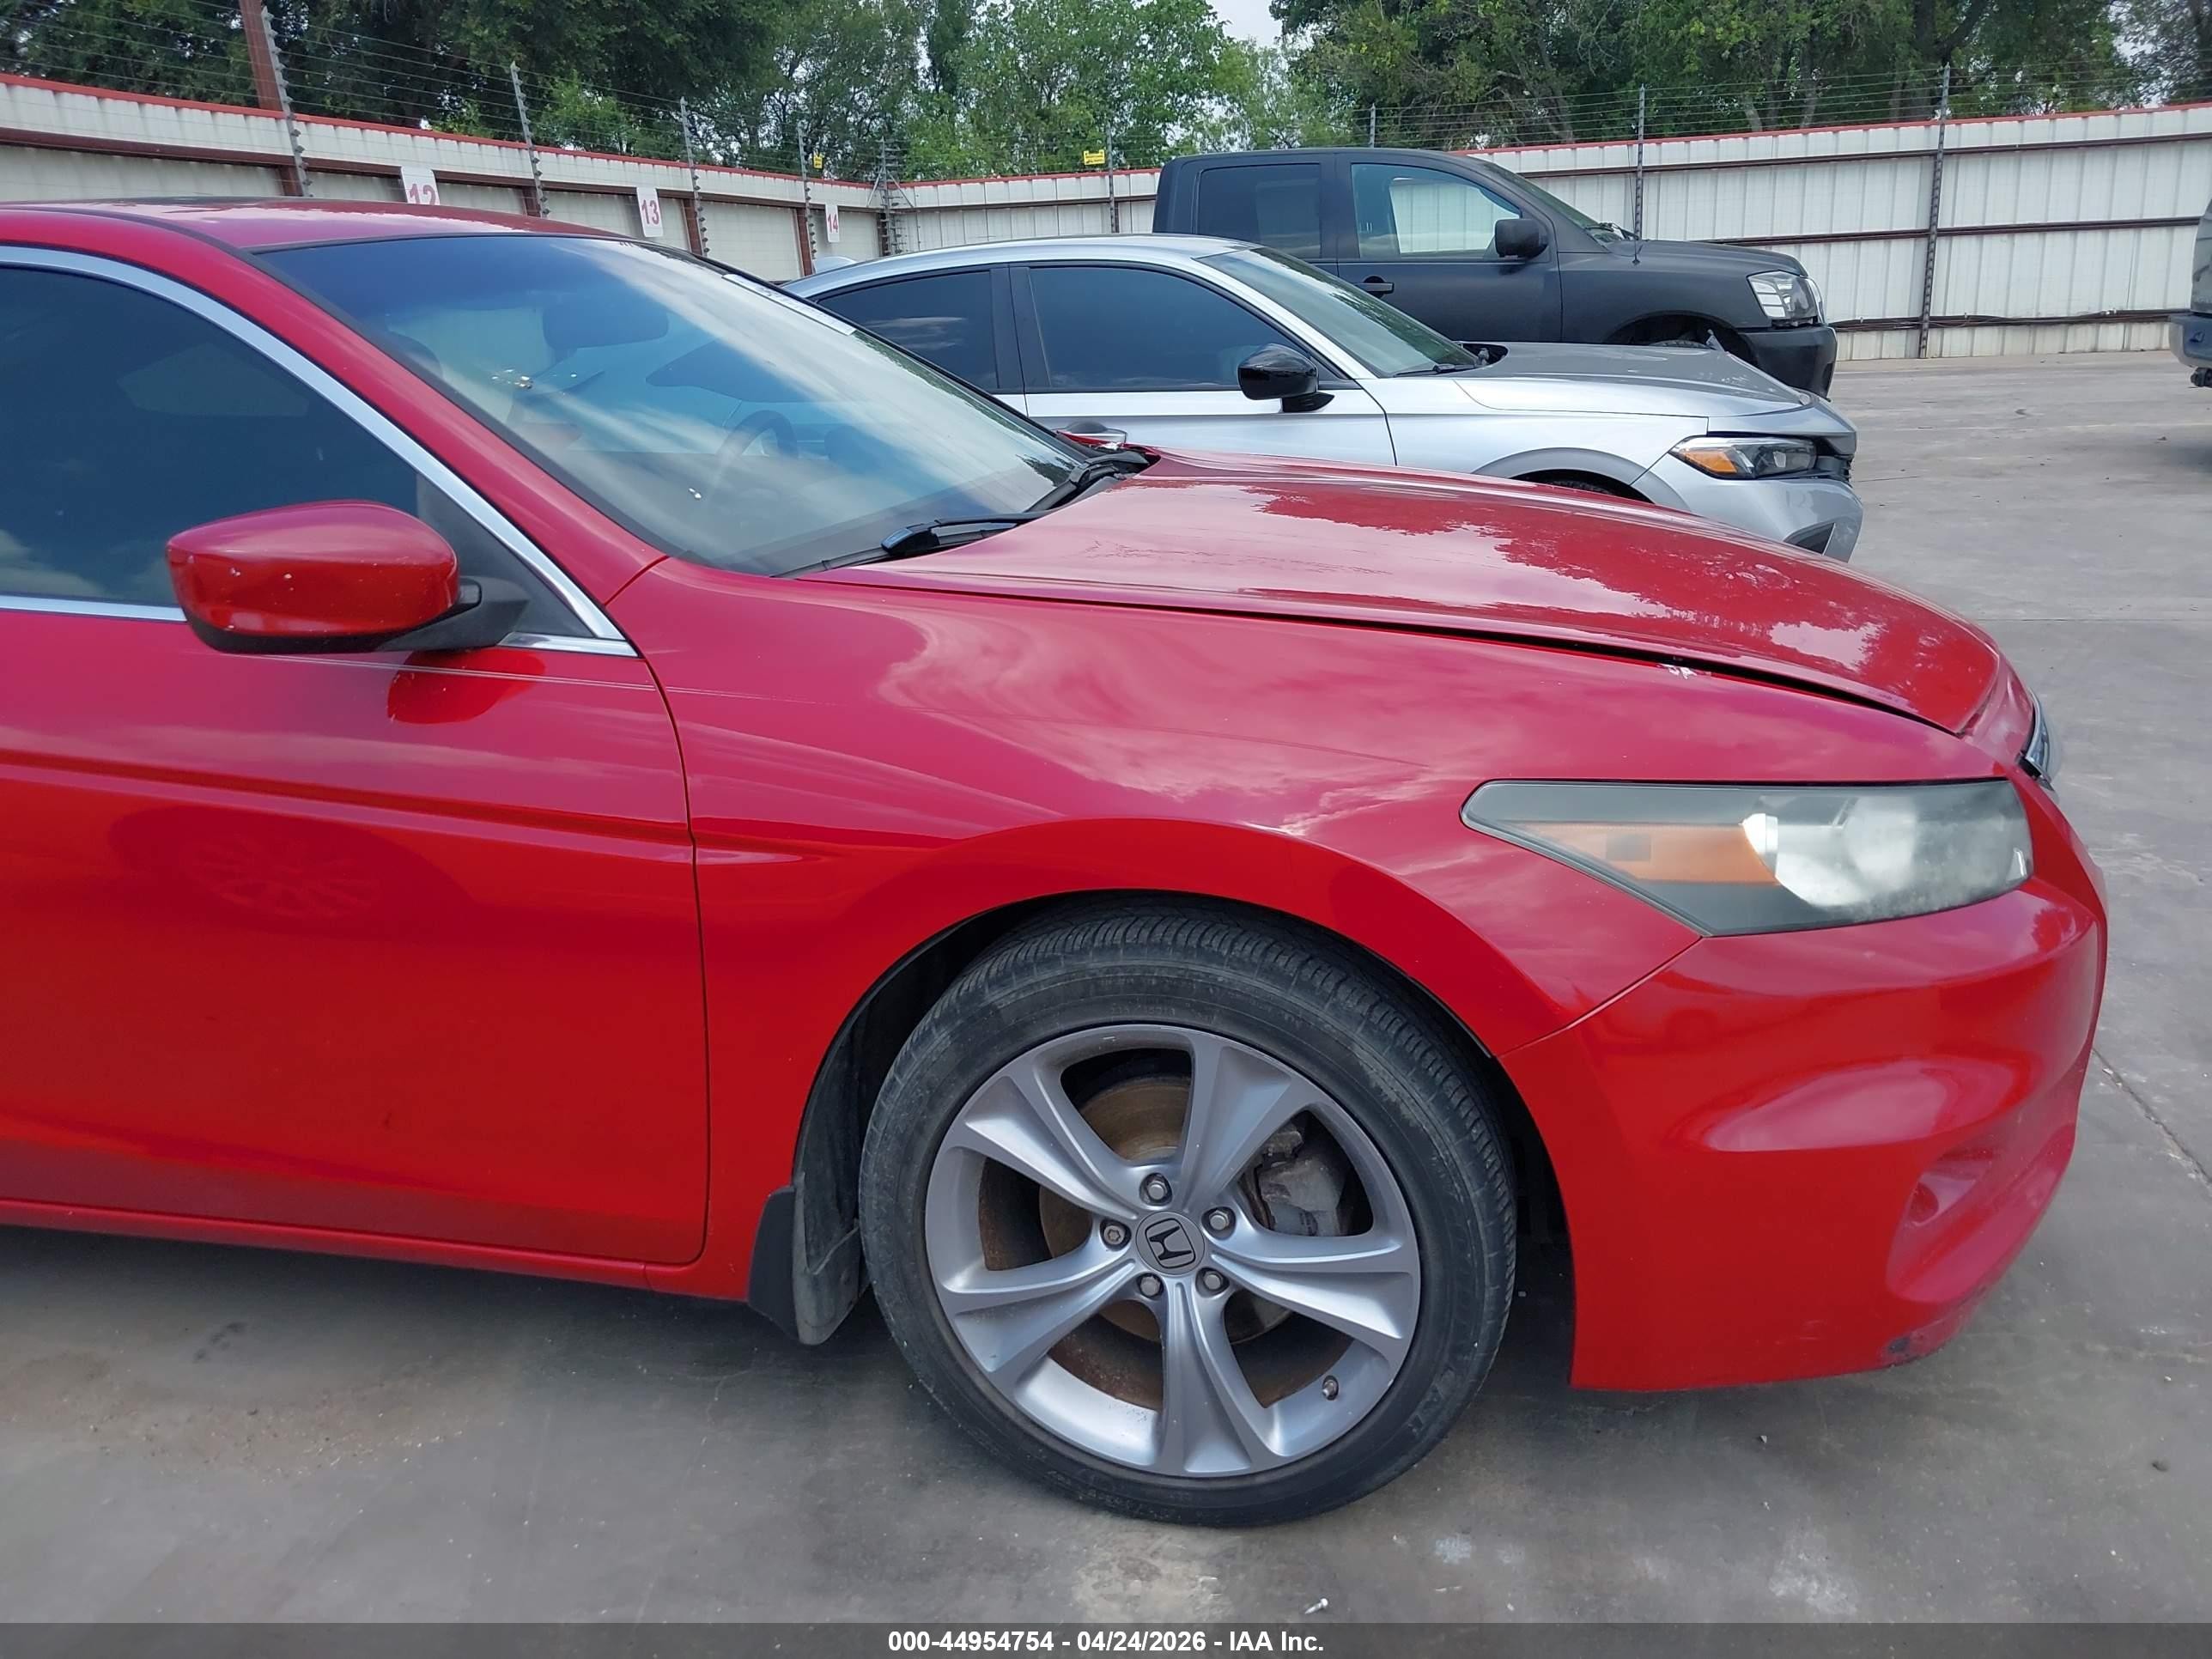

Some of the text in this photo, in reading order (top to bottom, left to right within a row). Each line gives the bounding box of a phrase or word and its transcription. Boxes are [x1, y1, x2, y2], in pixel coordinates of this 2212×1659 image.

[409, 183, 436, 205] 12
[641, 199, 660, 225] 13
[827, 213, 839, 234] 14
